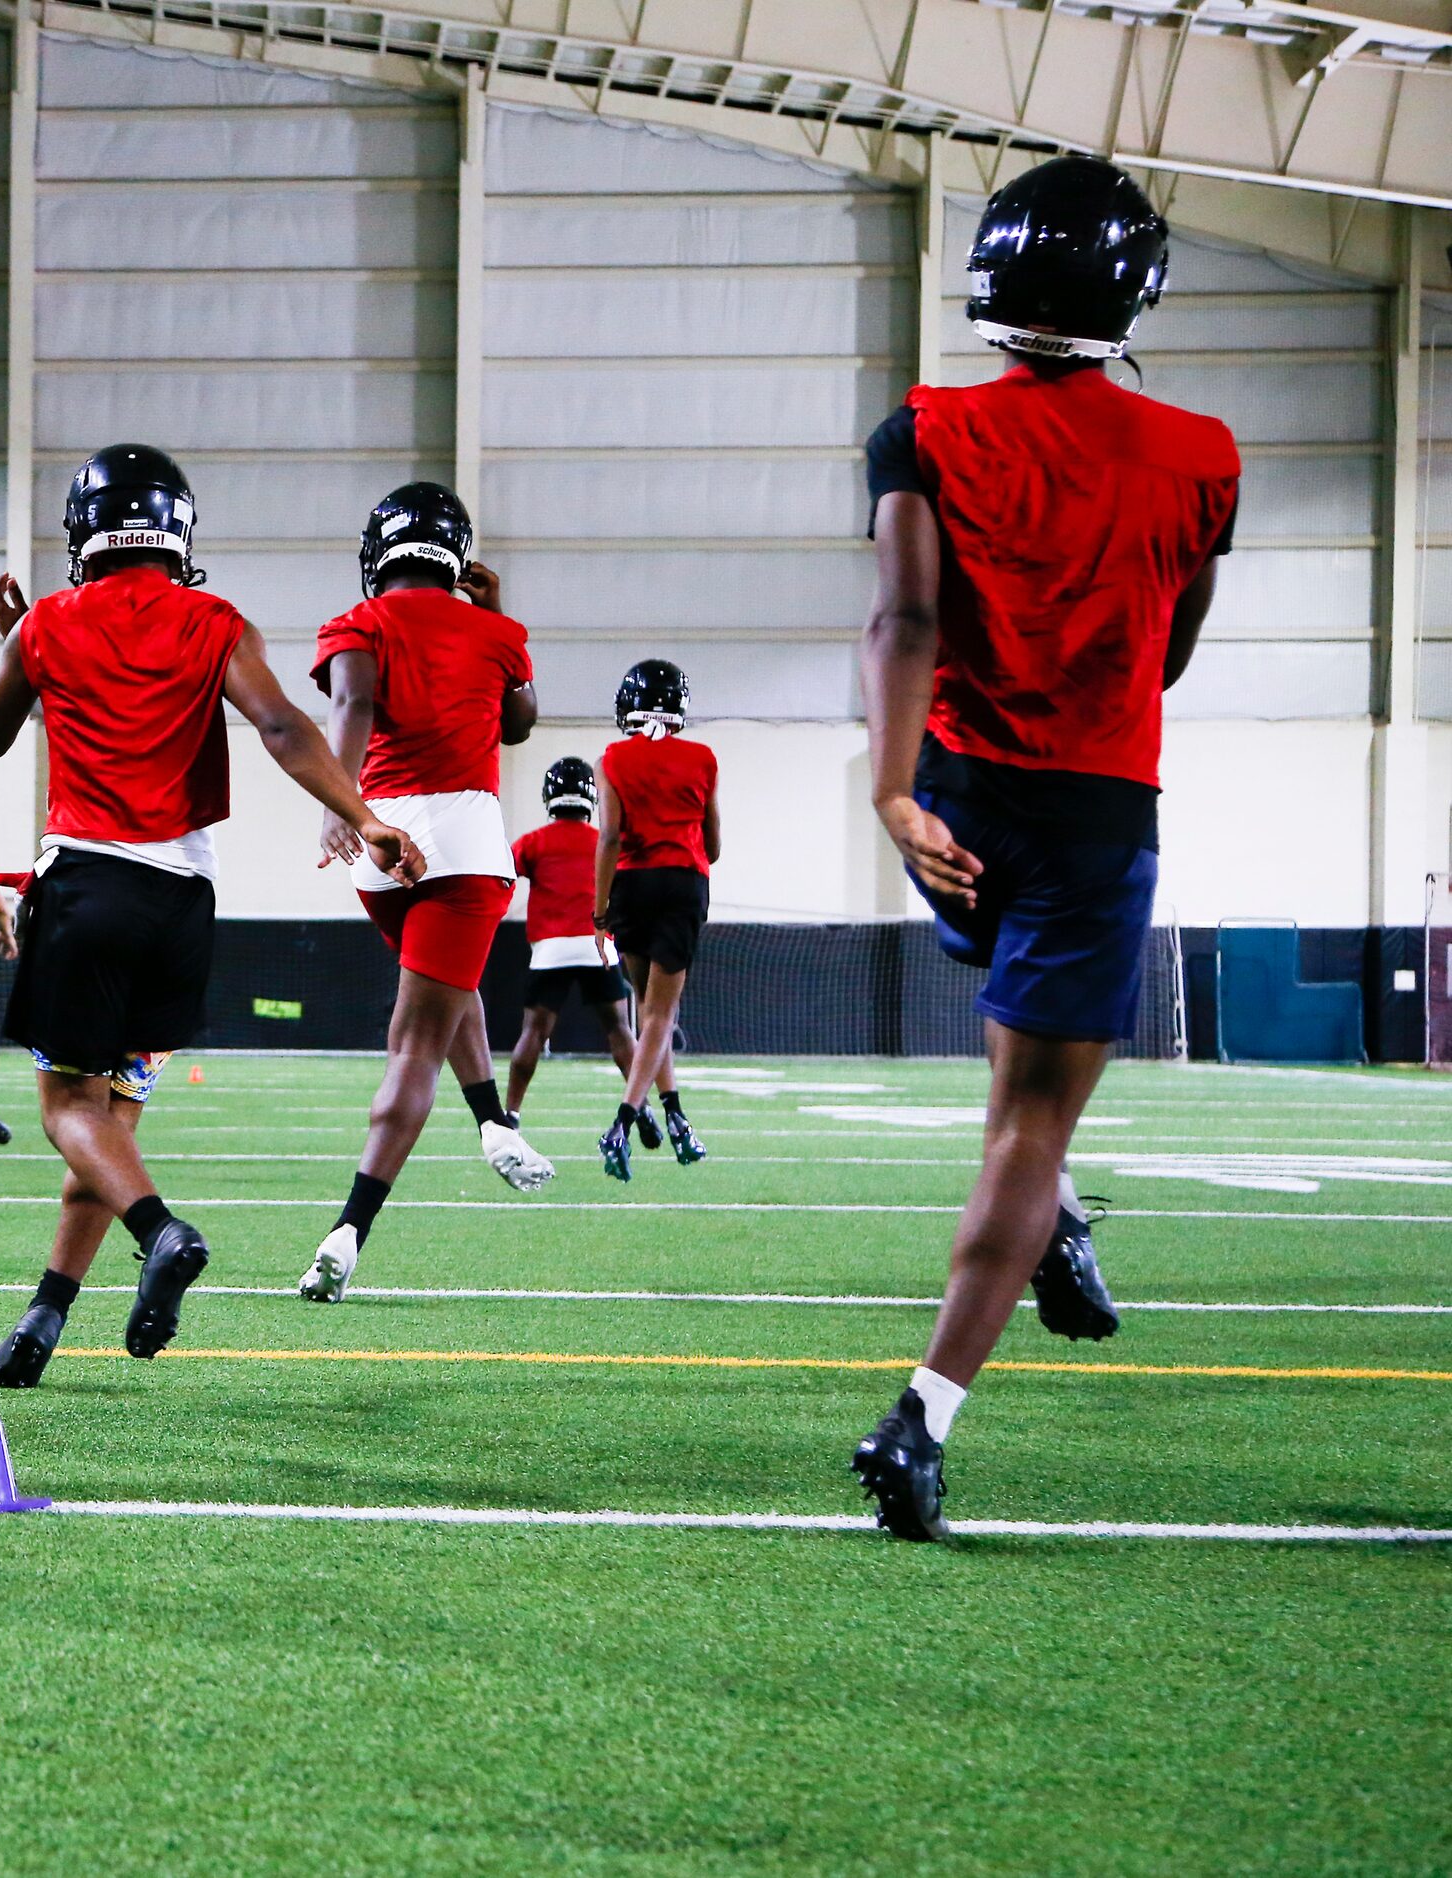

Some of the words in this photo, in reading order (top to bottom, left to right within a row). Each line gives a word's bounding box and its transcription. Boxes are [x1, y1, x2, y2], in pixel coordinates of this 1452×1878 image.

[1007, 333, 1075, 354] schutt
[108, 533, 165, 547] Riddell
[416, 546, 447, 560] schutt
